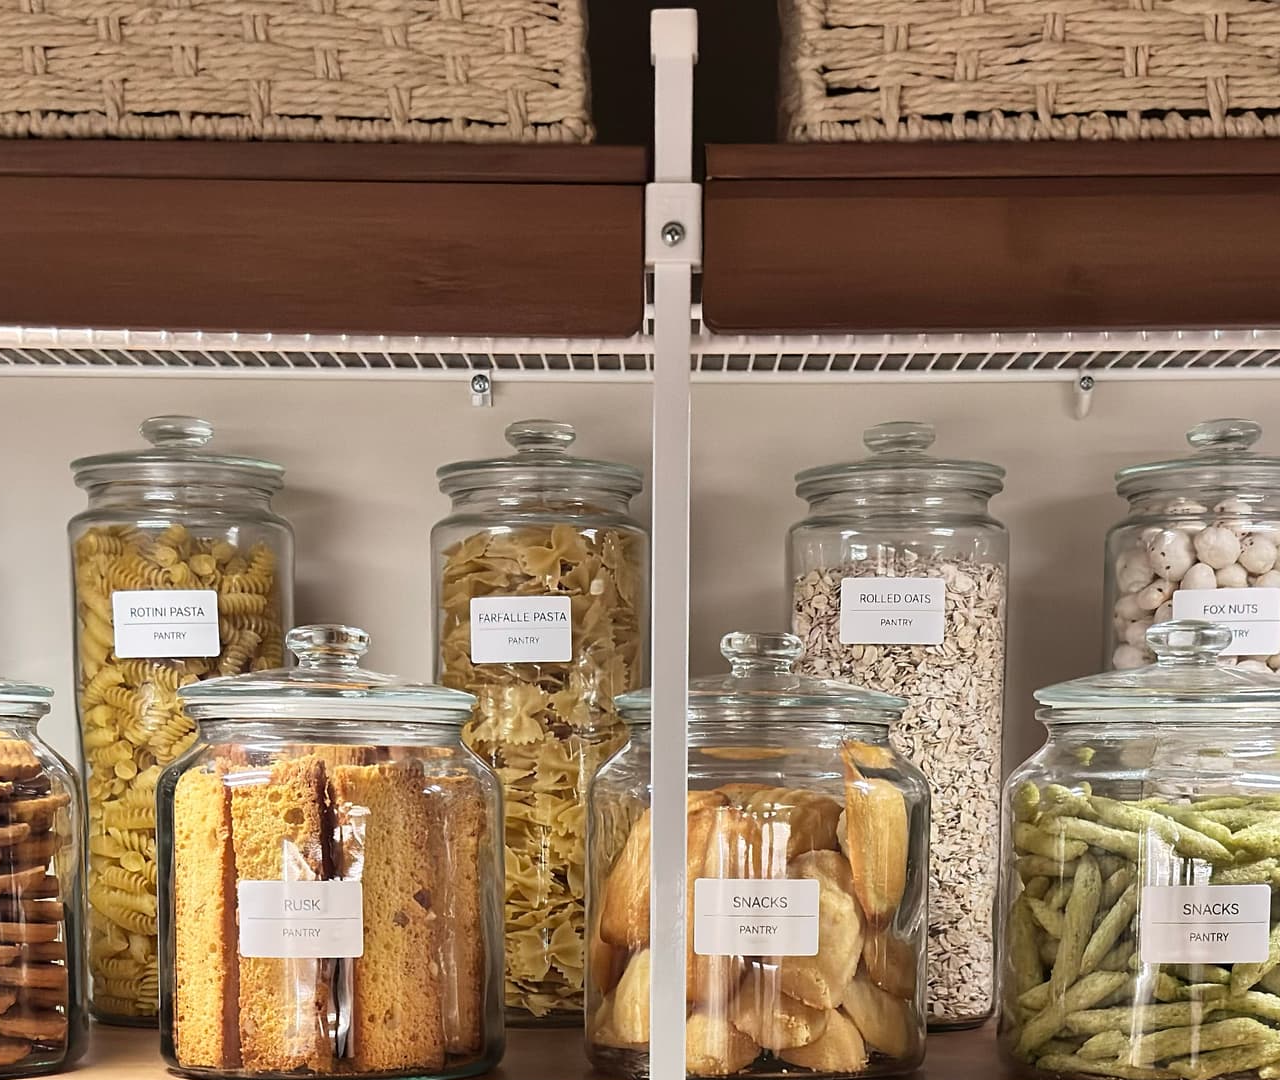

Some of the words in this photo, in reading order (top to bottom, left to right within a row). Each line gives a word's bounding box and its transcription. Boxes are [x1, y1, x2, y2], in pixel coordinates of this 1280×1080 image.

[859, 593, 902, 604] ROLLED
[903, 592, 932, 604] OATS
[129, 606, 167, 618] ROTINI
[170, 606, 206, 617] PASTA
[1203, 603, 1226, 615] FOX
[1227, 603, 1259, 615] NUTS
[478, 612, 530, 623] FARFALLE
[532, 611, 568, 622] PASTA
[880, 618, 914, 627] PANTRY
[153, 631, 187, 640] PANTRY
[507, 636, 541, 645] PANTRY
[284, 899, 321, 911] RUSK
[732, 896, 788, 910] SNACKS
[1182, 903, 1240, 916] SNACKS
[282, 928, 320, 937] PANTRY
[739, 926, 779, 936] PANTRY
[1189, 932, 1230, 943] PANTRY
